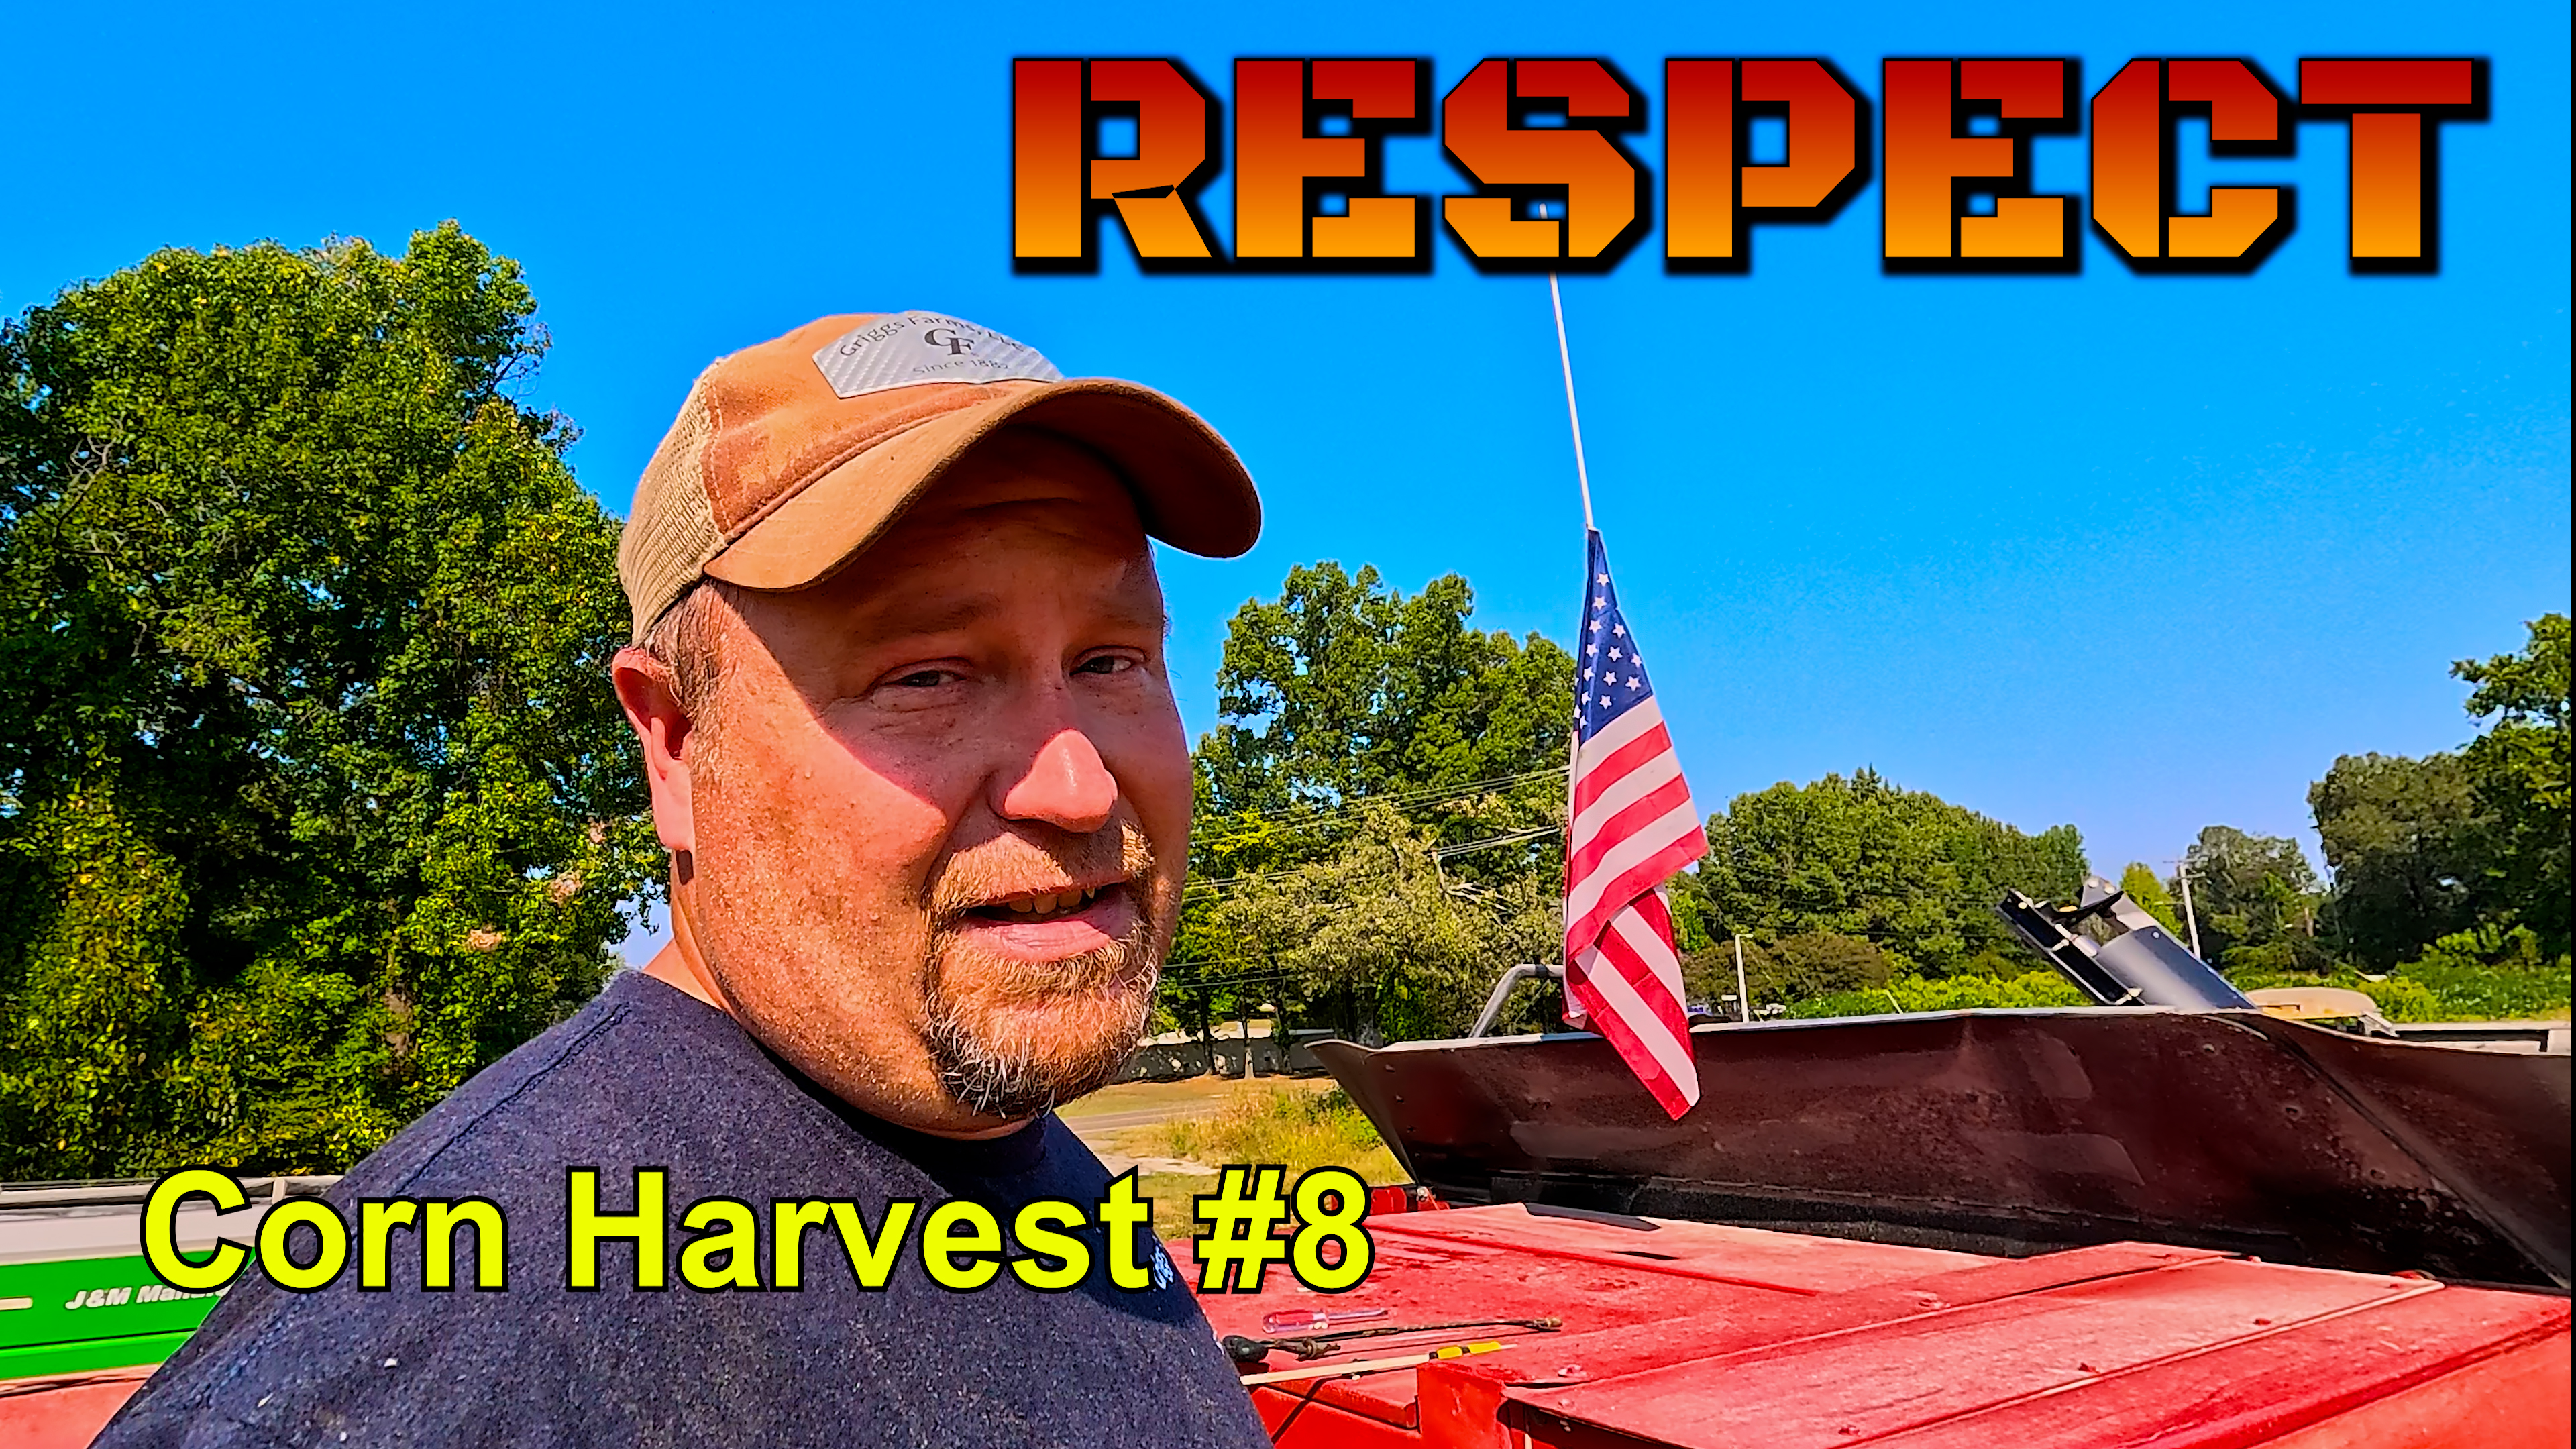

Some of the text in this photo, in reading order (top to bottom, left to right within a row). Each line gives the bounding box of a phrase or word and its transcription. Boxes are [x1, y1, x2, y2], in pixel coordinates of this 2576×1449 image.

[839, 321, 906, 356] Griggs
[912, 360, 964, 375] Since
[64, 1286, 133, 1309] J&M
